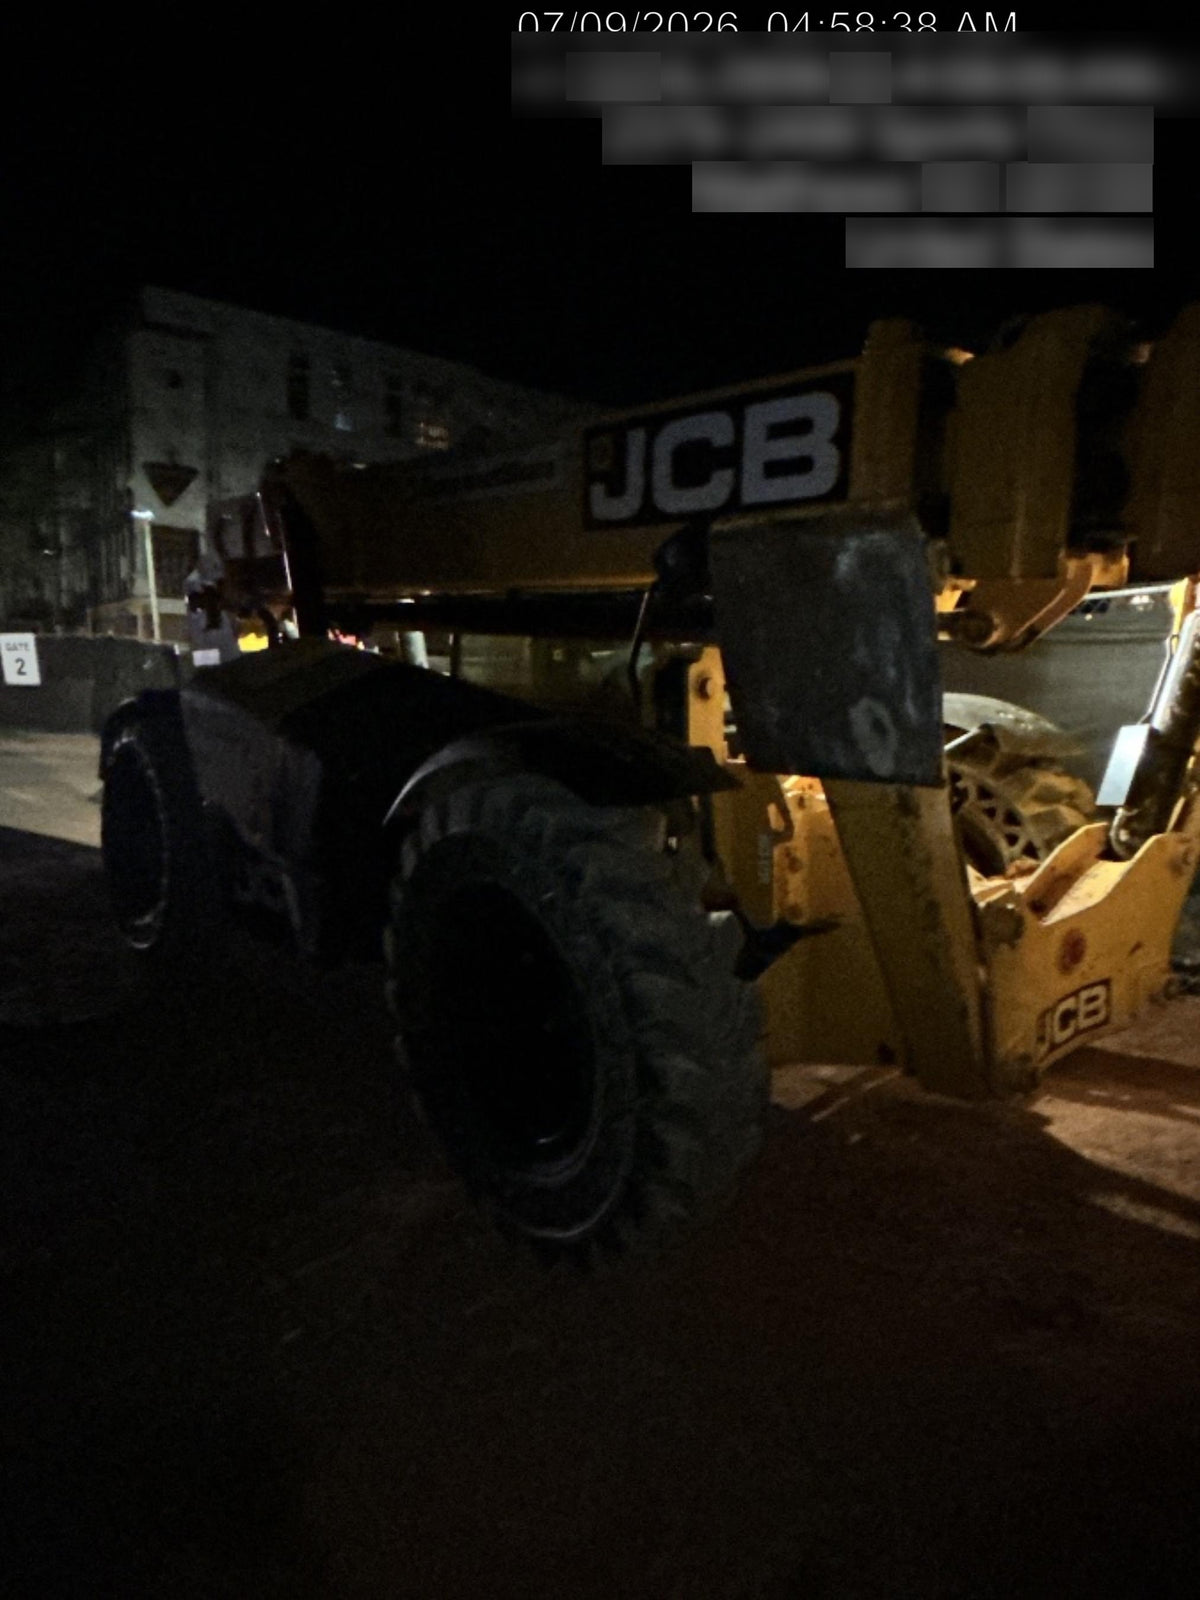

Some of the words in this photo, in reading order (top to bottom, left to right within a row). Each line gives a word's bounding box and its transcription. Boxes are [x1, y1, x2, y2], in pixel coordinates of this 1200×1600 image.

[589, 391, 843, 522] JCB
[15, 658, 27, 675] 2
[1036, 984, 1107, 1060] JCB
